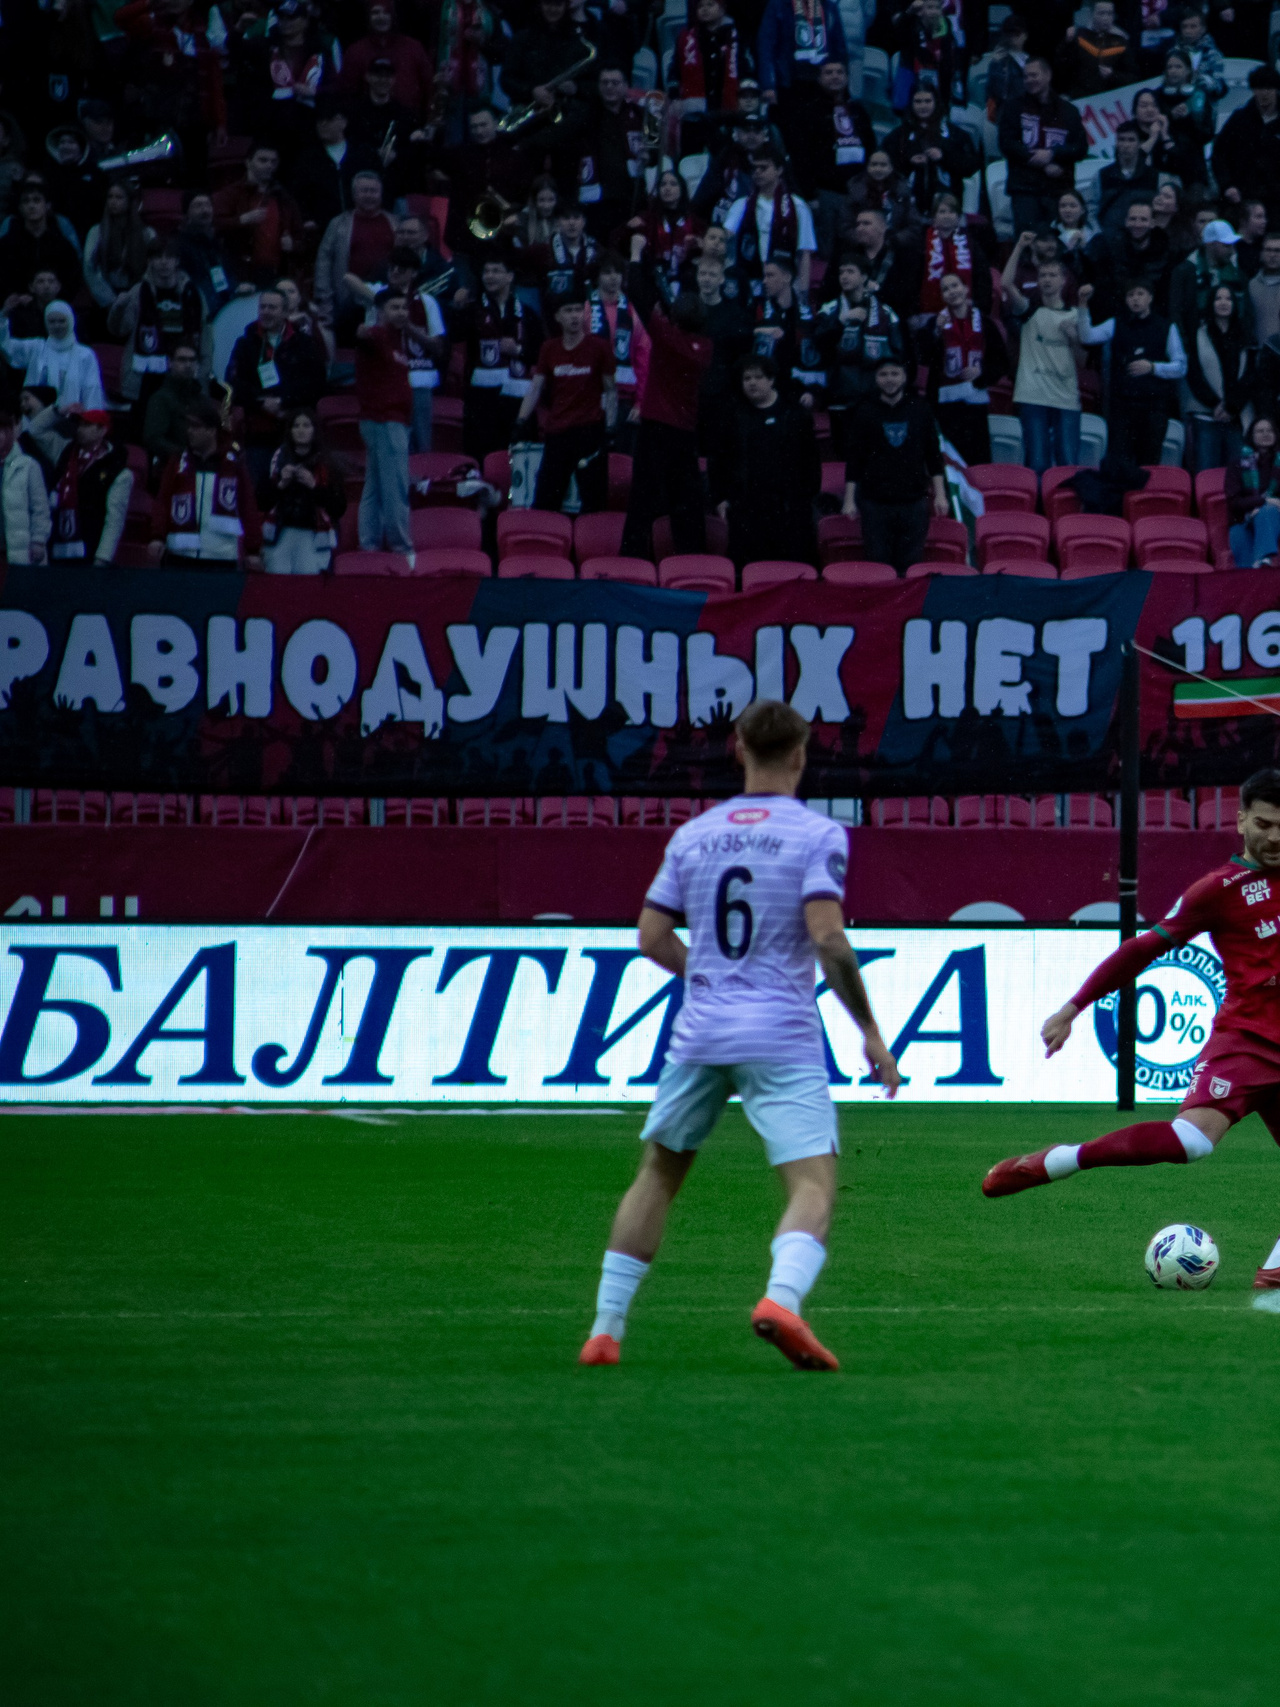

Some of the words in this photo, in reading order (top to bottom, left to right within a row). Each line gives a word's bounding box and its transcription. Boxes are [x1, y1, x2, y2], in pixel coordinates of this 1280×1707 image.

[0, 608, 855, 740] РАВНОДУШНЫХ
[903, 617, 1108, 721] НЕТ
[1241, 879, 1268, 897] FON
[1245, 888, 1272, 906] BET
[716, 866, 753, 961] 6
[1171, 991, 1207, 1007] Алк.
